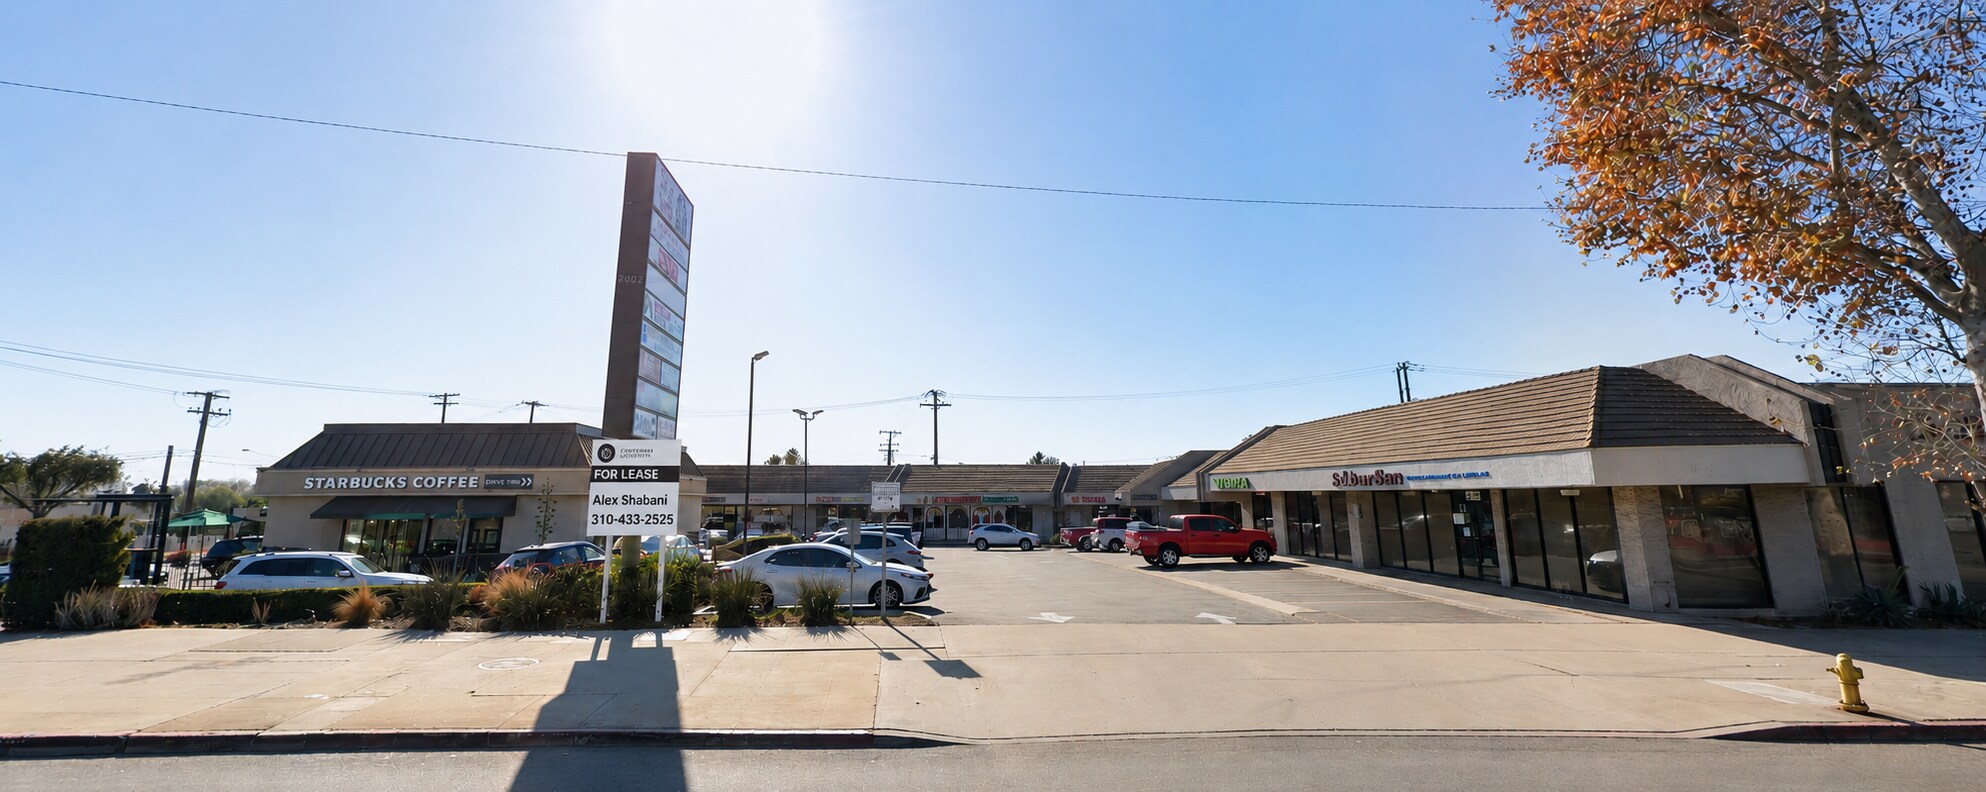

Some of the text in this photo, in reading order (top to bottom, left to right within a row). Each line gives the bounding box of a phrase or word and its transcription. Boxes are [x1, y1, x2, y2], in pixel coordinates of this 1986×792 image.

[618, 274, 644, 284] 2002
[594, 469, 659, 480] FOR LEASE
[303, 476, 479, 489] STARBUCKS COFFEE
[592, 494, 668, 506] Alex Shabani
[591, 513, 674, 525] 310-433-2525
